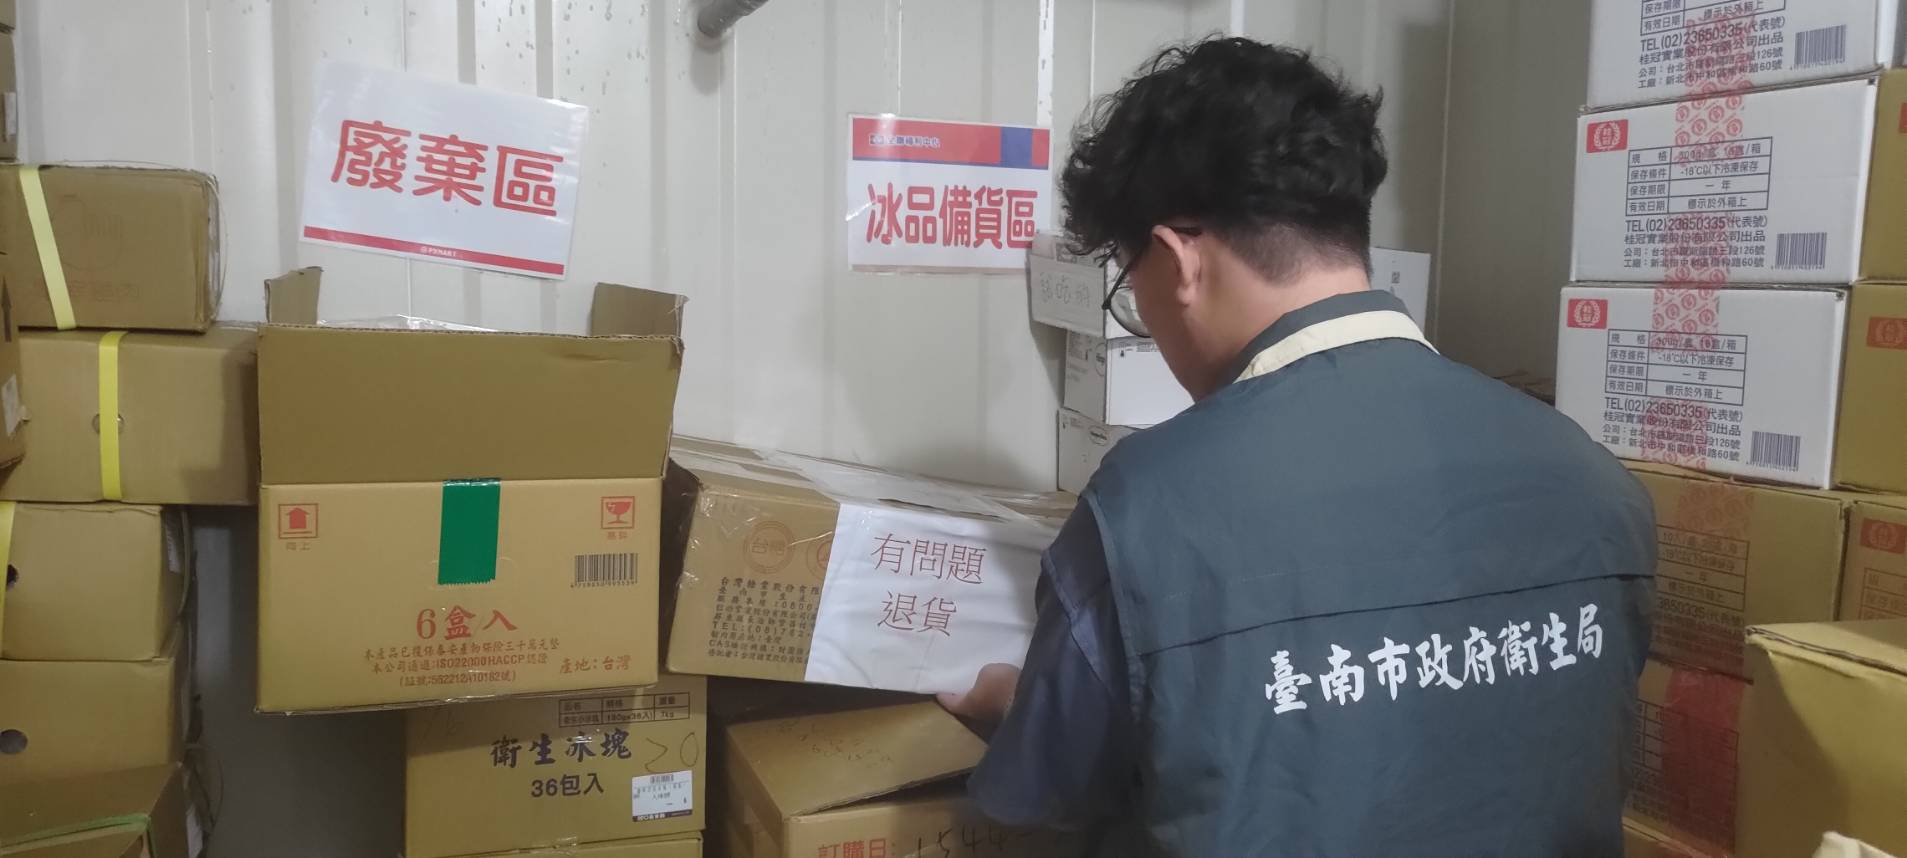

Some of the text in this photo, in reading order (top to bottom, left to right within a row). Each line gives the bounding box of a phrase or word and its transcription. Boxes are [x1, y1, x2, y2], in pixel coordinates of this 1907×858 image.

[1644, 15, 1681, 31] 有效日期
[331, 120, 564, 217] 廢棄區
[1631, 167, 1667, 180] 保存條件
[1630, 184, 1666, 197] 保存期限
[866, 182, 1038, 250] 冰品備貨區
[1629, 198, 1748, 213] 有效日期 標示於外箱上
[1610, 350, 1645, 361] 保存條件
[1609, 366, 1644, 377] 保存期限
[1608, 381, 1723, 400] 有效日期 標示於外箱上
[871, 533, 988, 585] 有問題
[416, 604, 517, 640] 6盒入
[877, 591, 958, 637] 退貨
[1265, 603, 1603, 715] 臺南市政府衛生局
[490, 728, 632, 768] 衛生冰塊
[531, 773, 604, 798] 36包入
